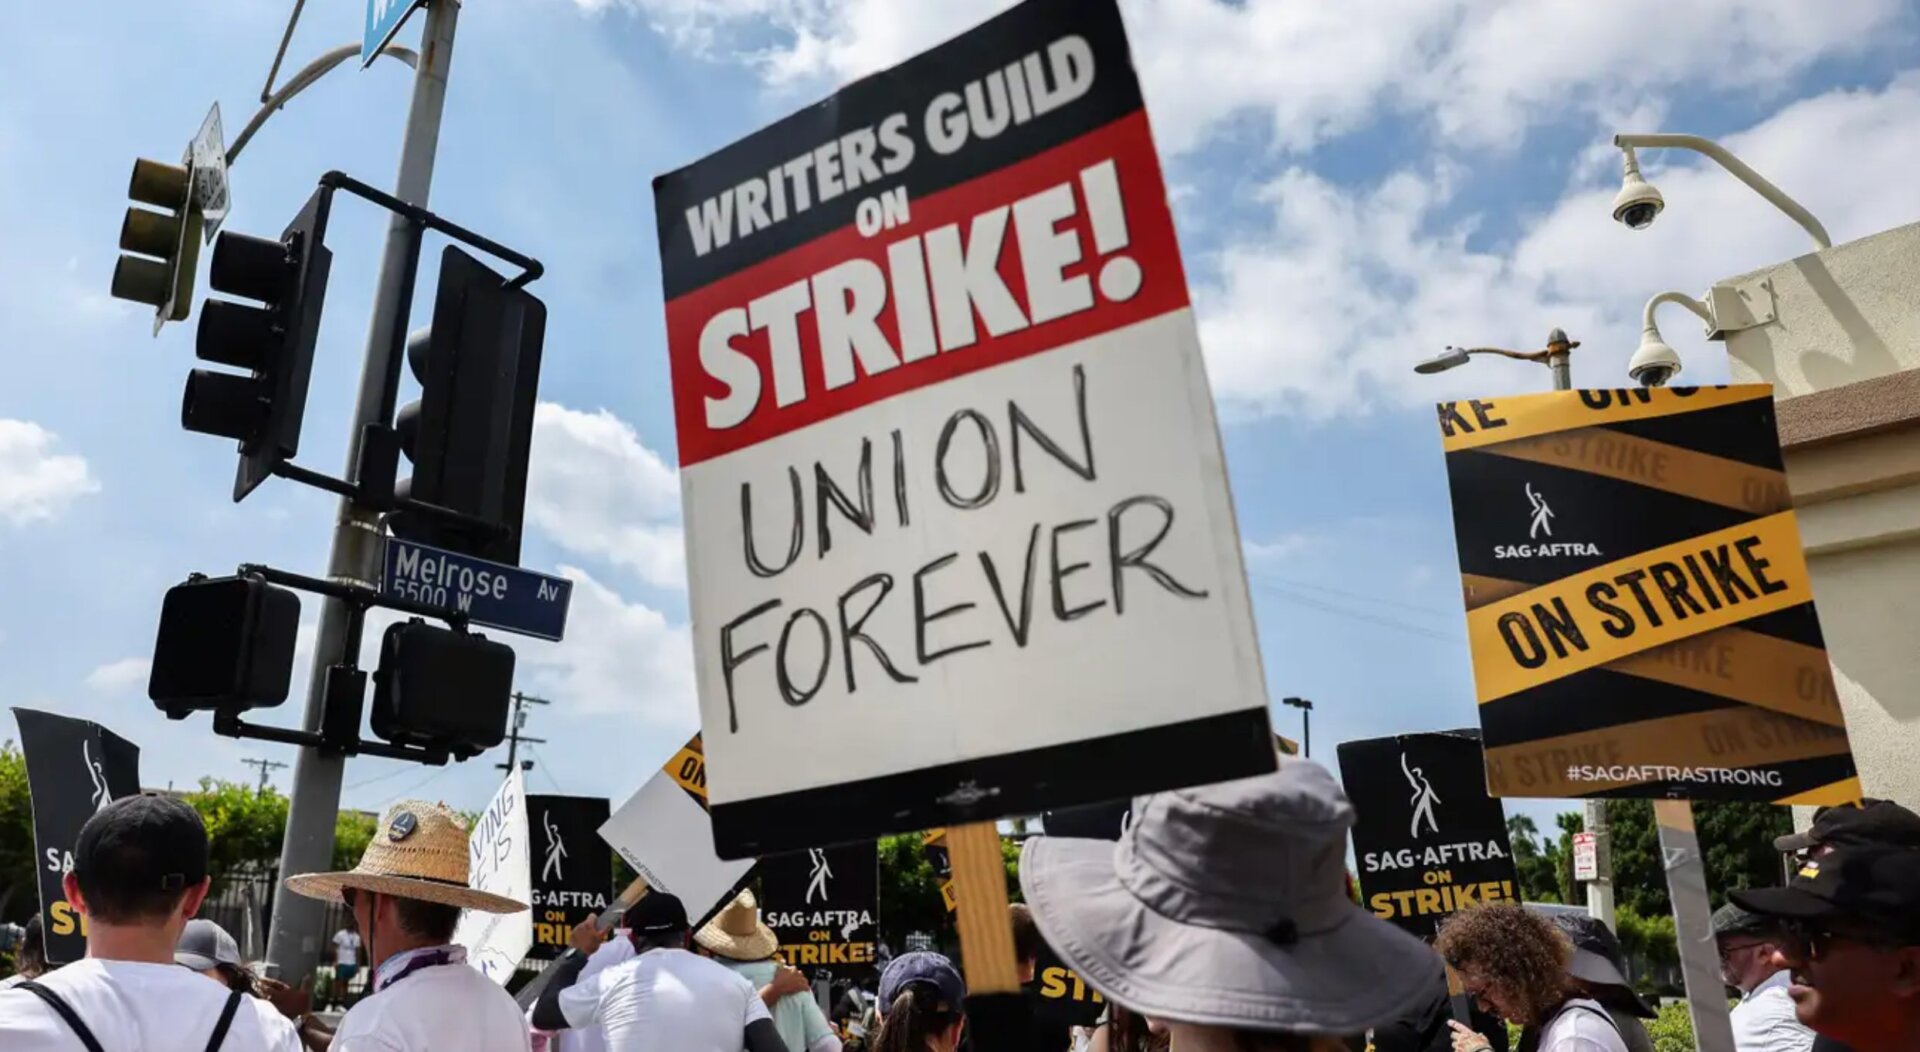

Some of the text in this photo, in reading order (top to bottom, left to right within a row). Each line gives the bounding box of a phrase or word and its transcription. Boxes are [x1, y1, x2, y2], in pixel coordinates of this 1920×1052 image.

[686, 35, 1096, 257] WRITERS GUILD
[855, 186, 911, 238] ON
[698, 158, 1142, 430] STRIKE!
[741, 364, 1096, 578] UNION
[395, 545, 560, 602] Melrose Av
[720, 495, 1209, 733] FOREVER
[1497, 535, 1788, 669] ON STRIKE
[1566, 765, 1783, 787] #SAGAFTRASTRONG
[1370, 880, 1515, 919] STRIKE!
[1423, 870, 1453, 885] ON
[544, 910, 566, 922] ON
[808, 930, 831, 943] ON
